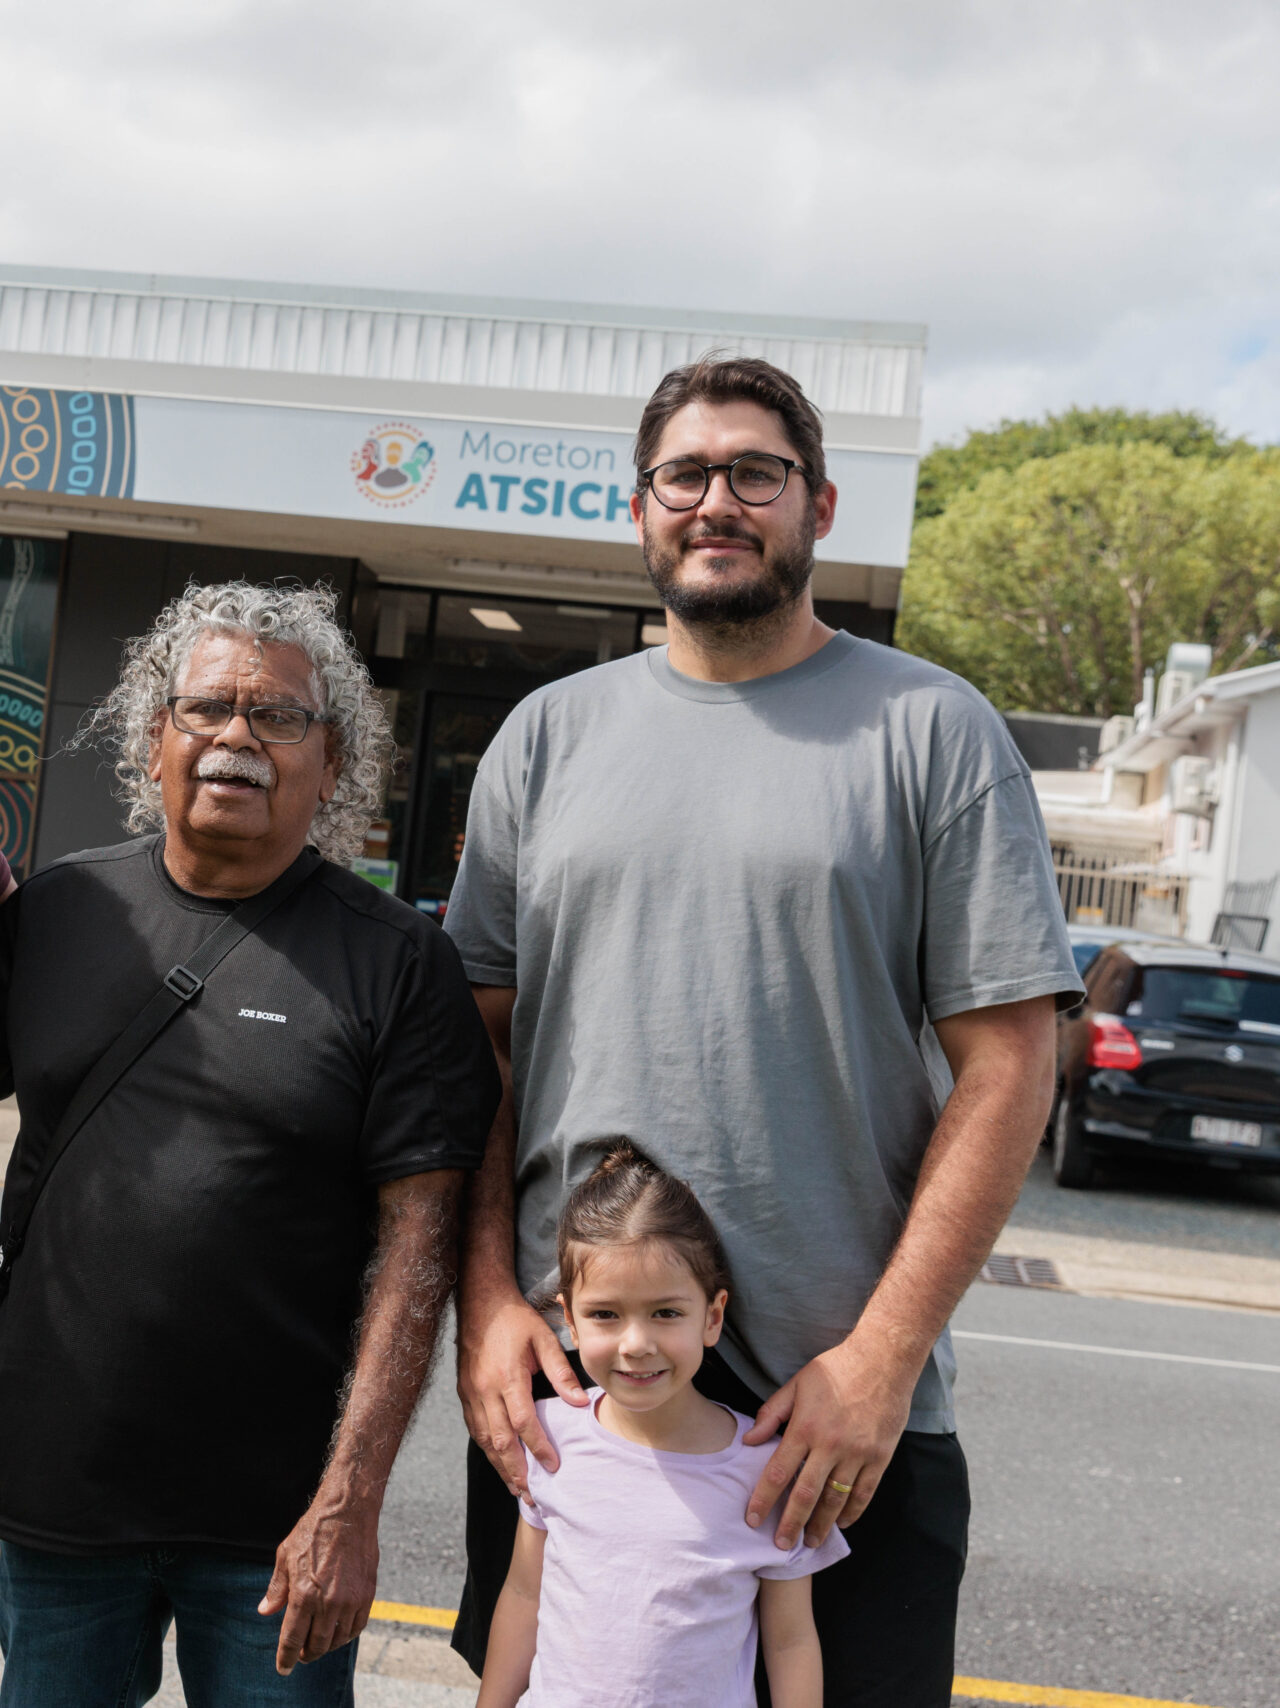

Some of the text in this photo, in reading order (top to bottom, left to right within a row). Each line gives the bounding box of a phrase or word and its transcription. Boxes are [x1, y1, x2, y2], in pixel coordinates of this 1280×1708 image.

[459, 430, 616, 472] Moreton
[454, 472, 634, 524] ATSICH
[238, 1008, 287, 1024] JOE BOXER
